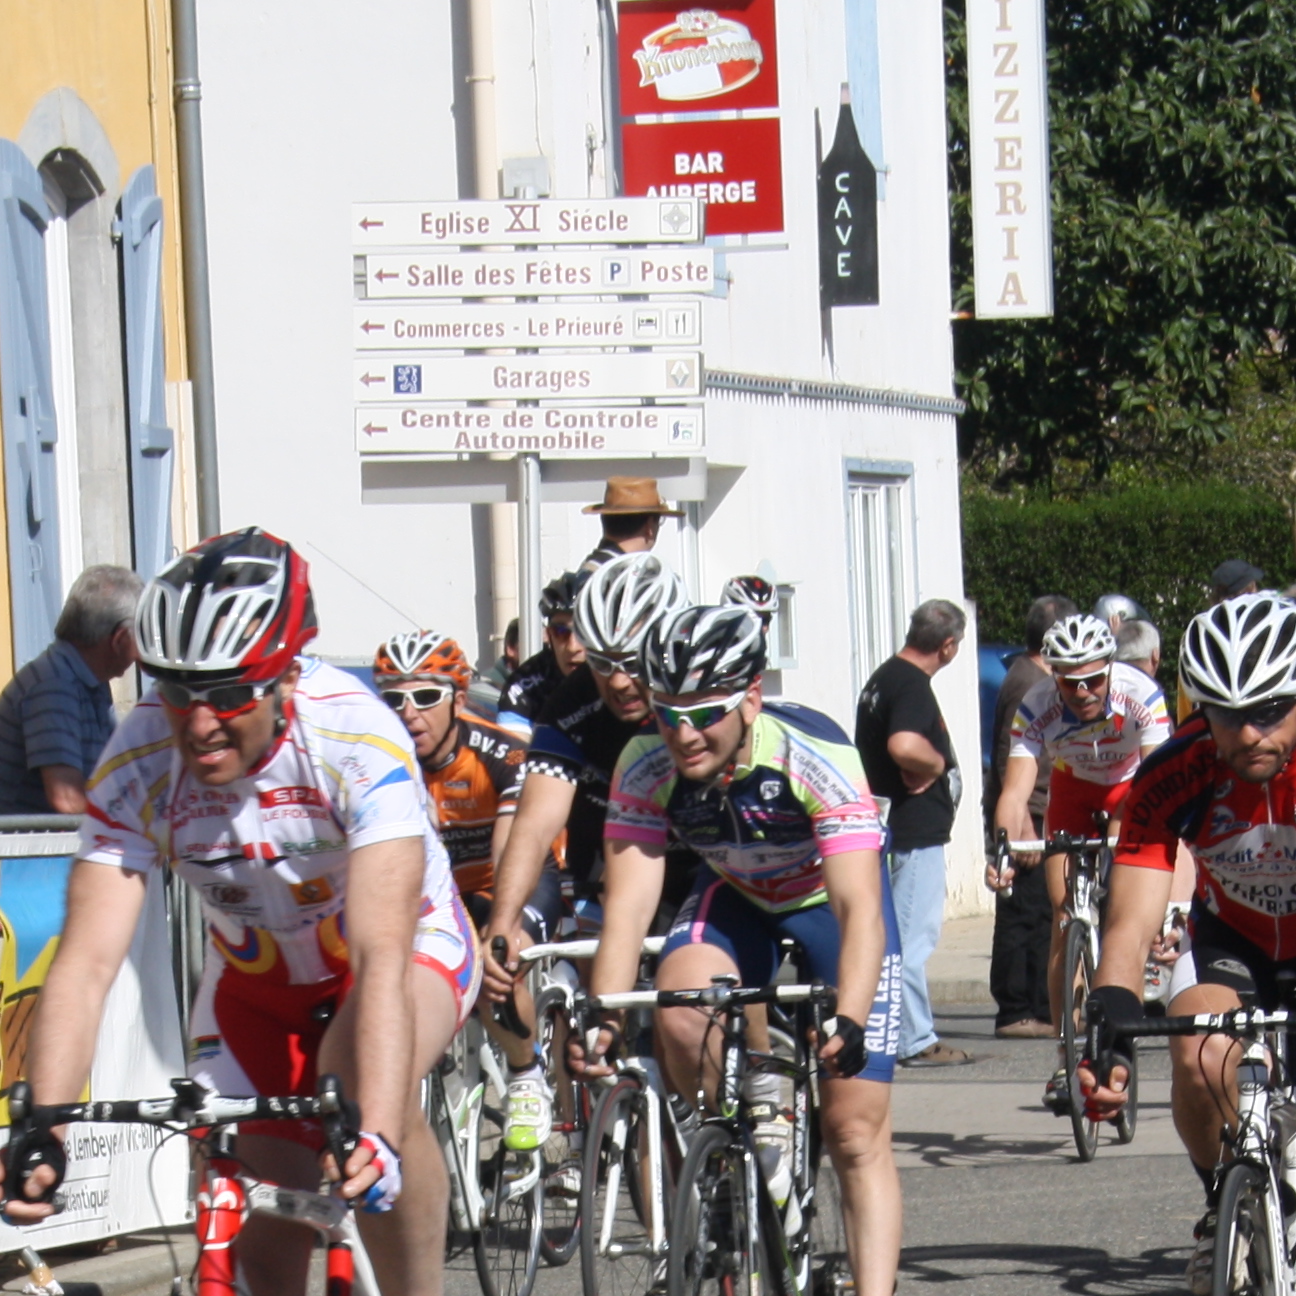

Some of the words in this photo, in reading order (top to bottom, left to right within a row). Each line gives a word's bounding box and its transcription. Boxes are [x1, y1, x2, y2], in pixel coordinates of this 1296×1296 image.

[673, 152, 725, 176] BAR
[420, 211, 491, 239] Eglise
[504, 204, 541, 232] XI
[834, 172, 853, 278] CAVE
[406, 263, 465, 288] Salle
[474, 263, 516, 286] des
[525, 260, 593, 284] Fêtes
[609, 261, 622, 282] P
[640, 260, 709, 282] Poste
[393, 318, 506, 339] Commerces
[527, 316, 550, 337] Le
[555, 314, 624, 337] Prieuré
[492, 366, 592, 393] Garages
[400, 408, 492, 429] Centre
[502, 408, 533, 428] de
[544, 408, 660, 429] Controle
[454, 430, 607, 451] Automobile
[886, 953, 903, 1056] REYNAERS
[864, 1012, 887, 1053] ALU
